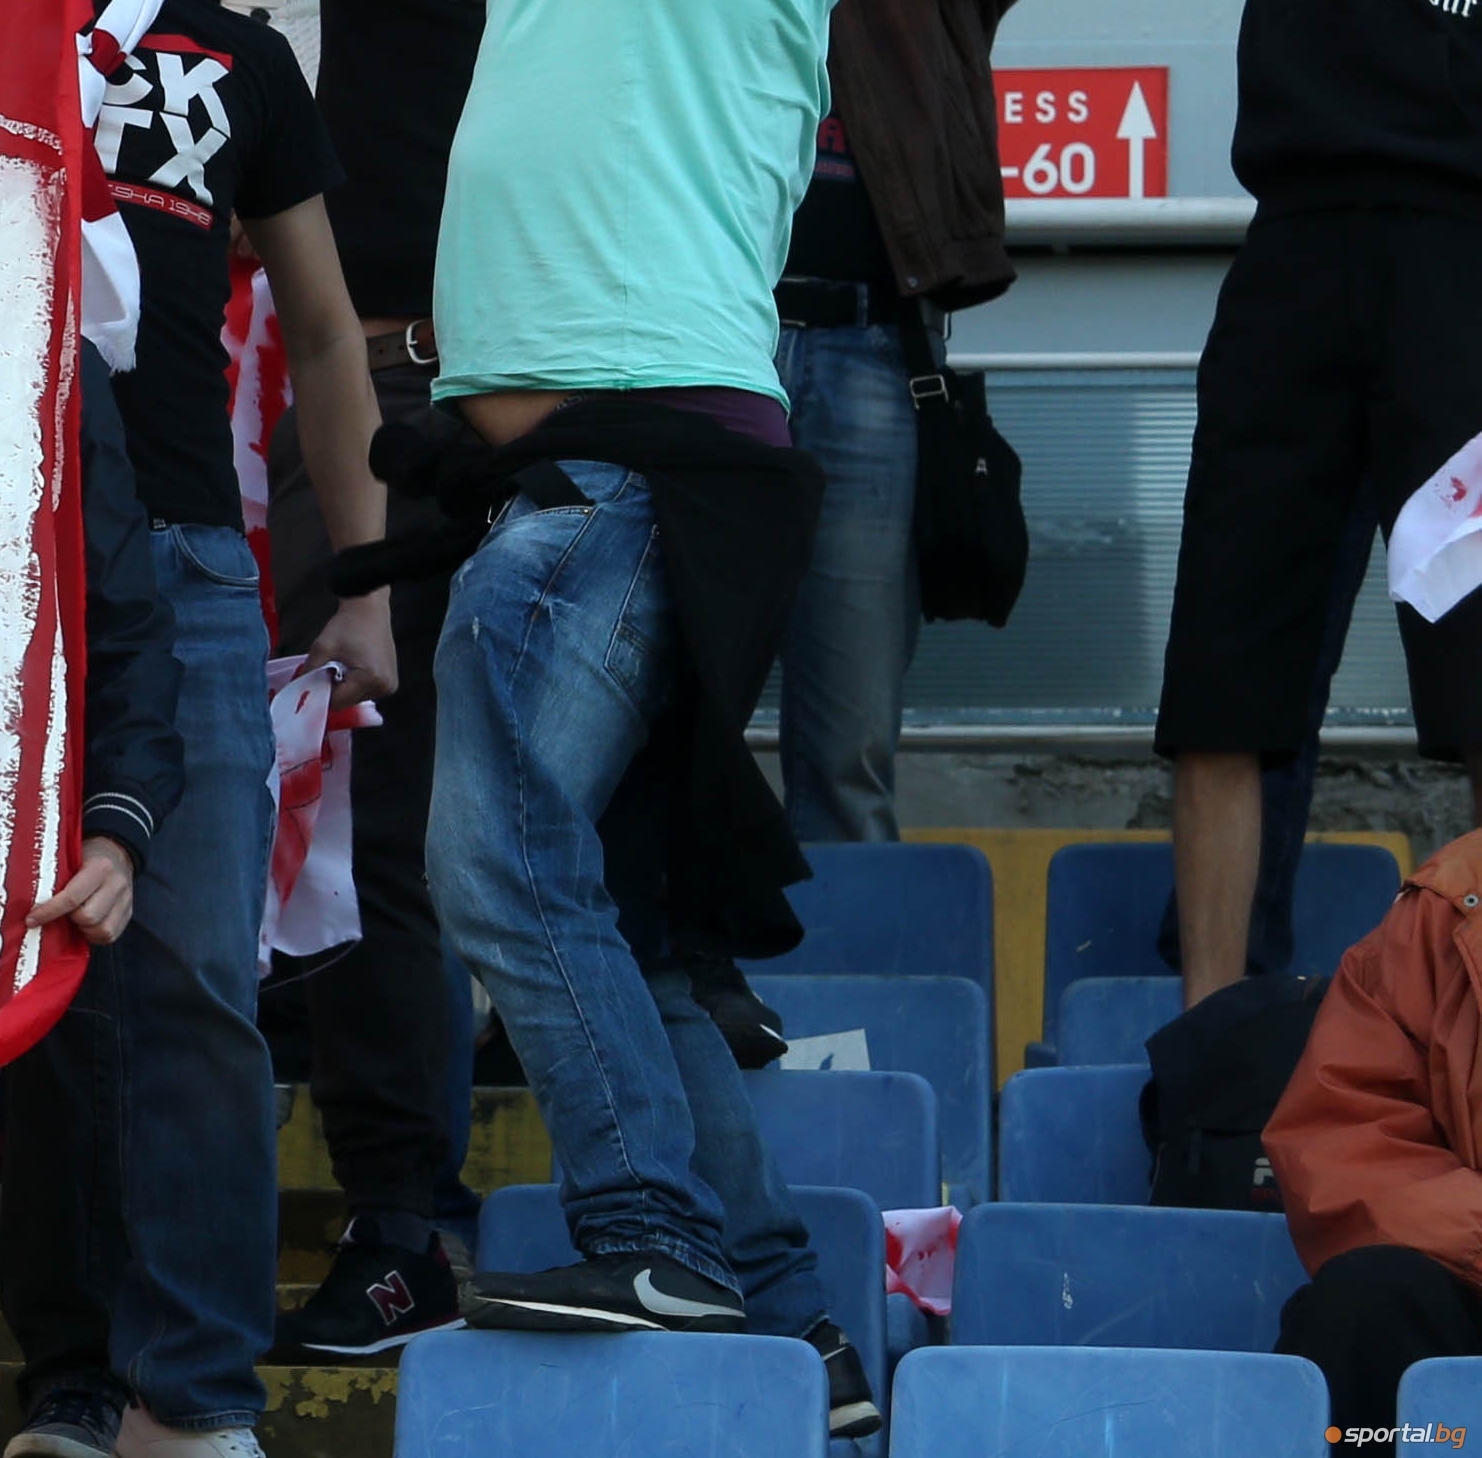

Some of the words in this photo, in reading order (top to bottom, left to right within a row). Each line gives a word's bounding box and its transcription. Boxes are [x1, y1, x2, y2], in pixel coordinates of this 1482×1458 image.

[1004, 89, 1089, 123] ESS
[999, 141, 1095, 194] -60
[366, 1269, 415, 1326] N
